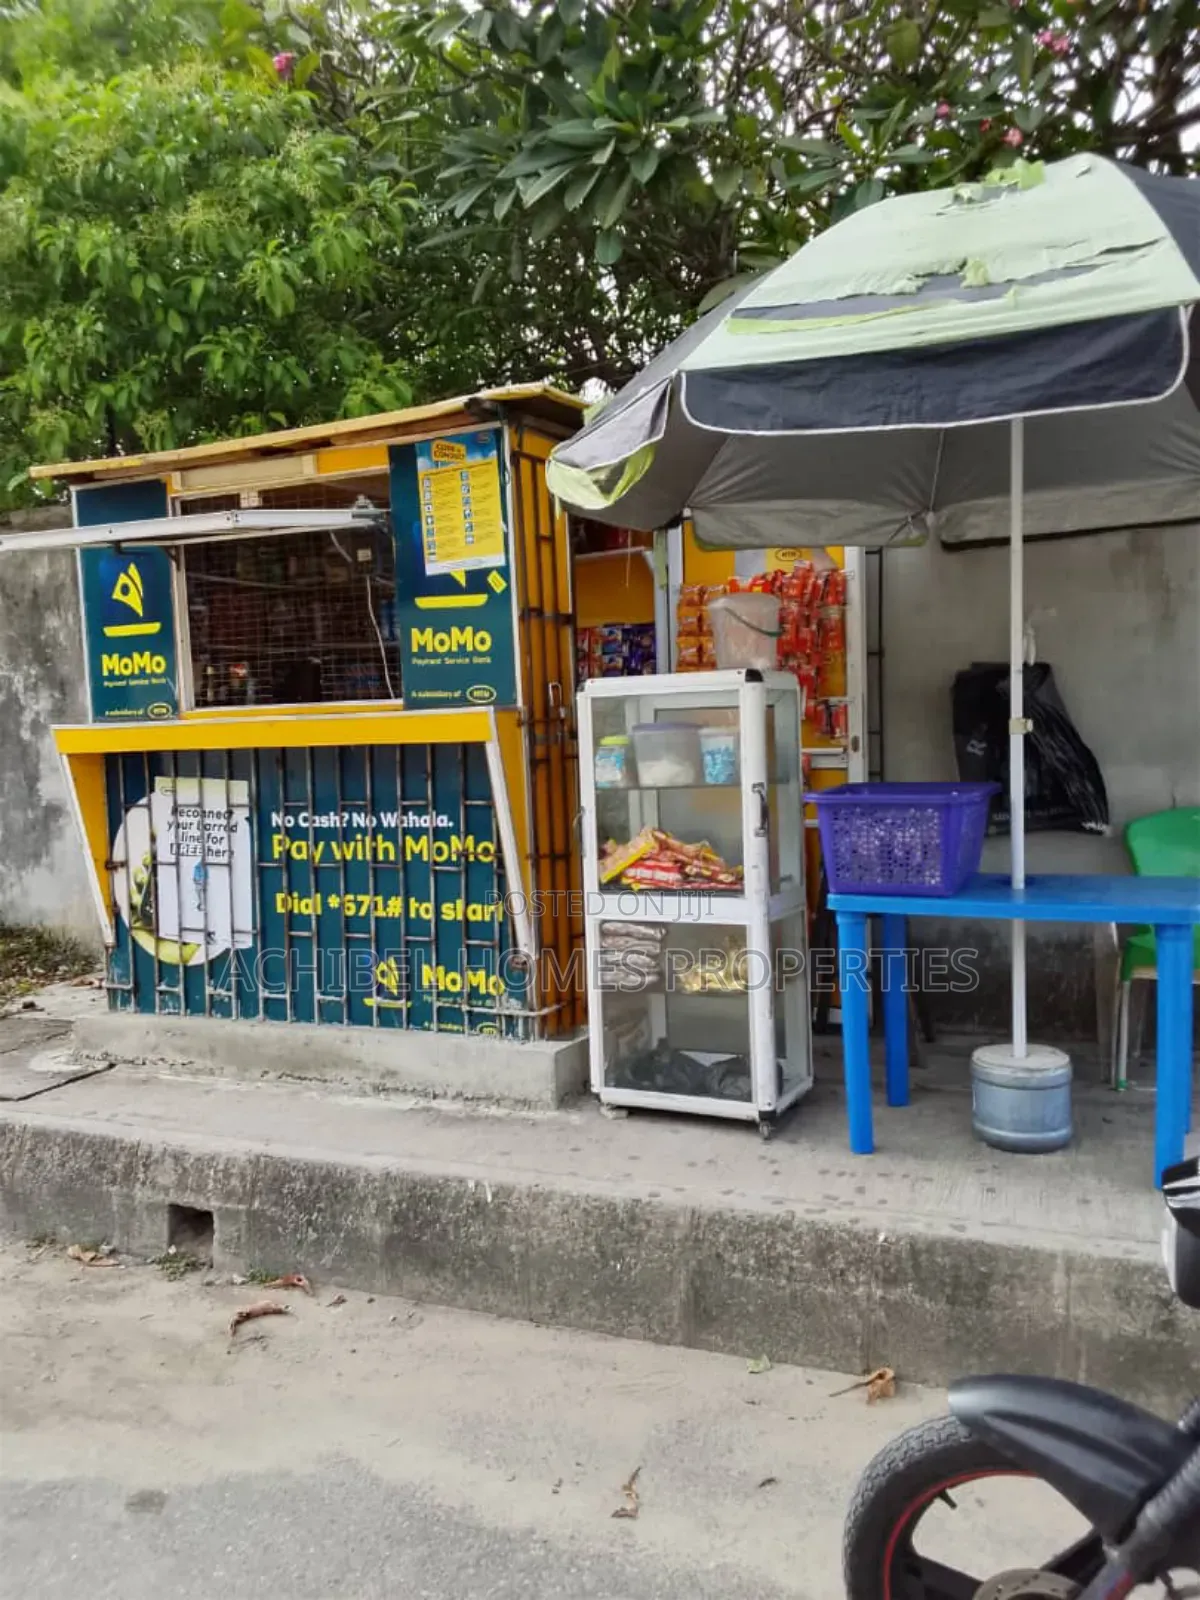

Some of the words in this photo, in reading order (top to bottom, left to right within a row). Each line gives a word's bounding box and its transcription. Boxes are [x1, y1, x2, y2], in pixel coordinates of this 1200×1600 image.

[410, 626, 493, 653] MoMo
[102, 652, 166, 676] MoMo
[411, 656, 442, 666] Payment
[444, 656, 470, 665] Service
[271, 811, 295, 828] No
[298, 811, 349, 828] Cash?
[352, 811, 377, 828] No
[380, 810, 454, 829] Wahala.
[206, 833, 225, 845] for
[272, 833, 325, 866] Pay
[330, 833, 396, 861] with
[405, 834, 496, 862] MoMo
[275, 891, 323, 916] Dial
[408, 896, 434, 919] to
[441, 898, 503, 922] start
[421, 963, 506, 997] MoMo
